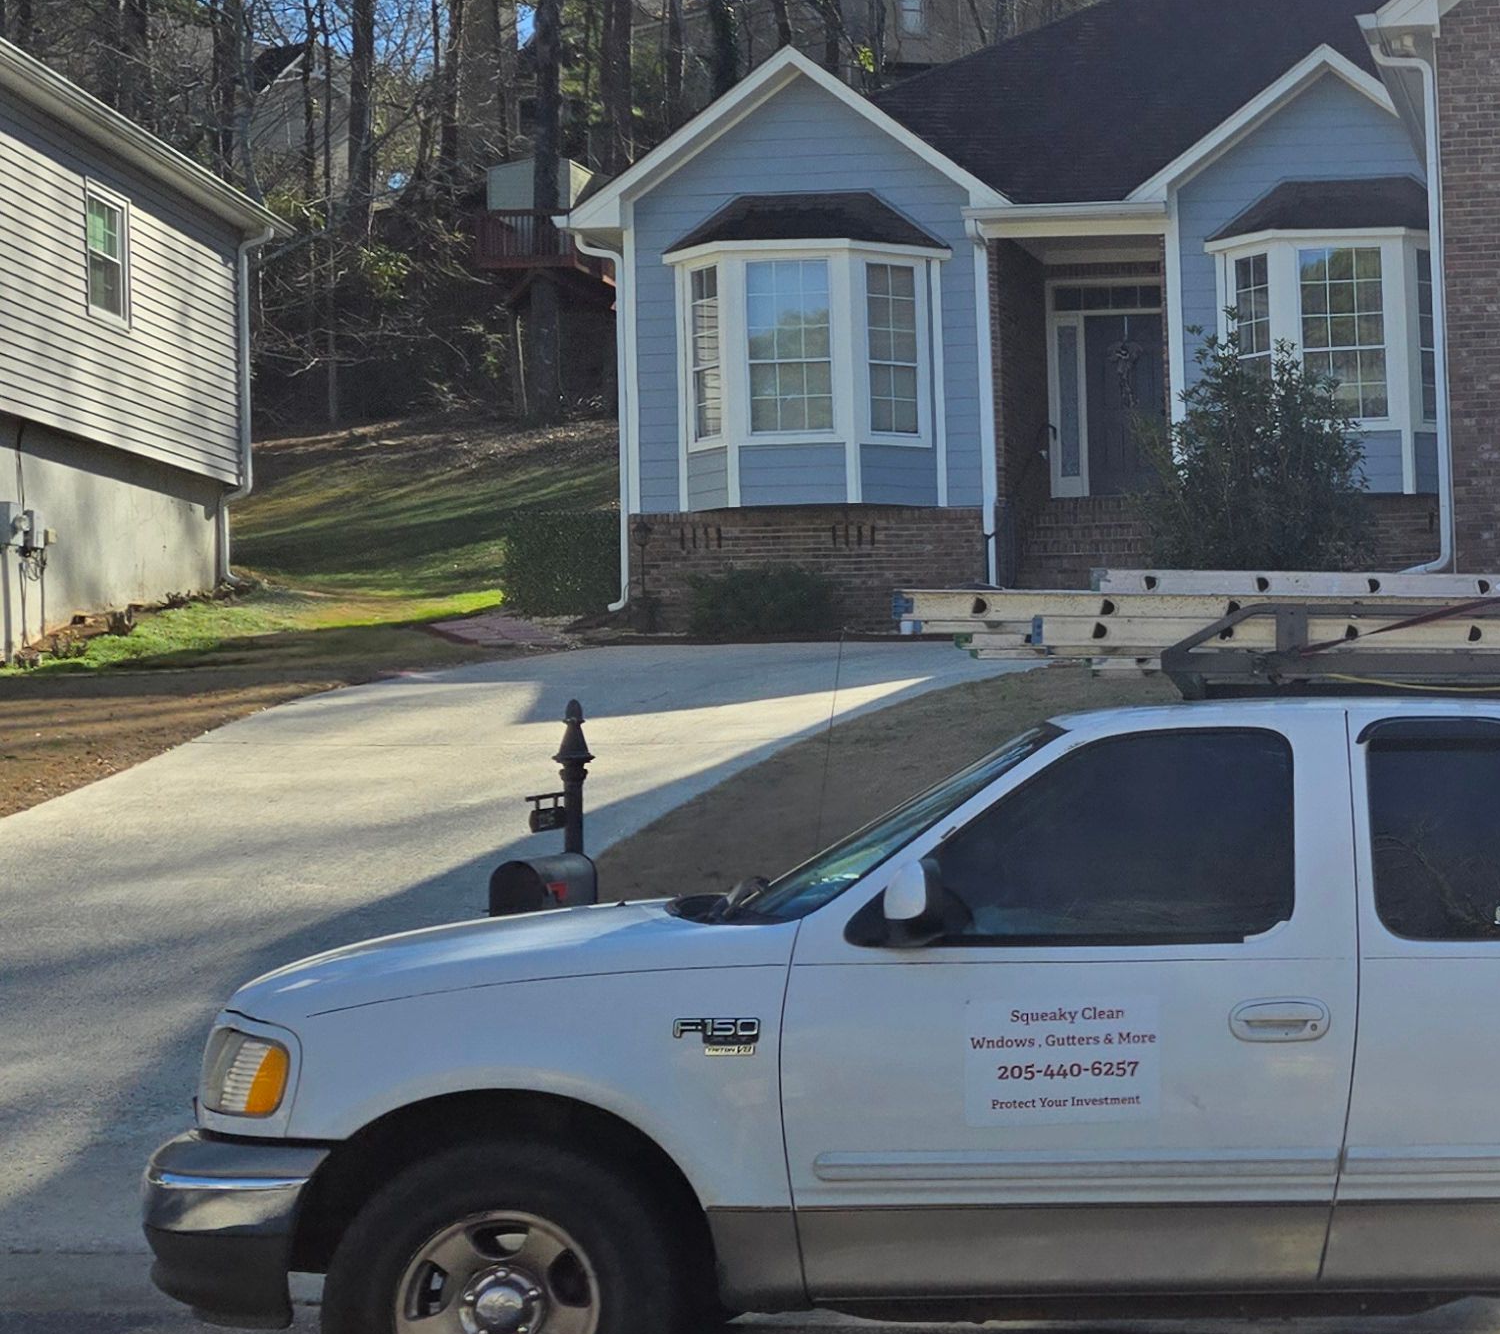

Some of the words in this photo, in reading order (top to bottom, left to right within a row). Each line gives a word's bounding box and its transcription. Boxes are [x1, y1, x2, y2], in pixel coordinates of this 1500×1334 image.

[1009, 1007, 1078, 1025] Squeaky
[1081, 1006, 1125, 1020] Clean
[673, 1018, 759, 1037] F-150
[1045, 1034, 1100, 1047] Gutters
[1103, 1034, 1114, 1045] &
[1118, 1032, 1156, 1045] More
[997, 1060, 1140, 1080] 205-440-6257
[991, 1098, 1036, 1110] Protect
[1039, 1097, 1069, 1108] Your
[1071, 1095, 1140, 1107] Investment
